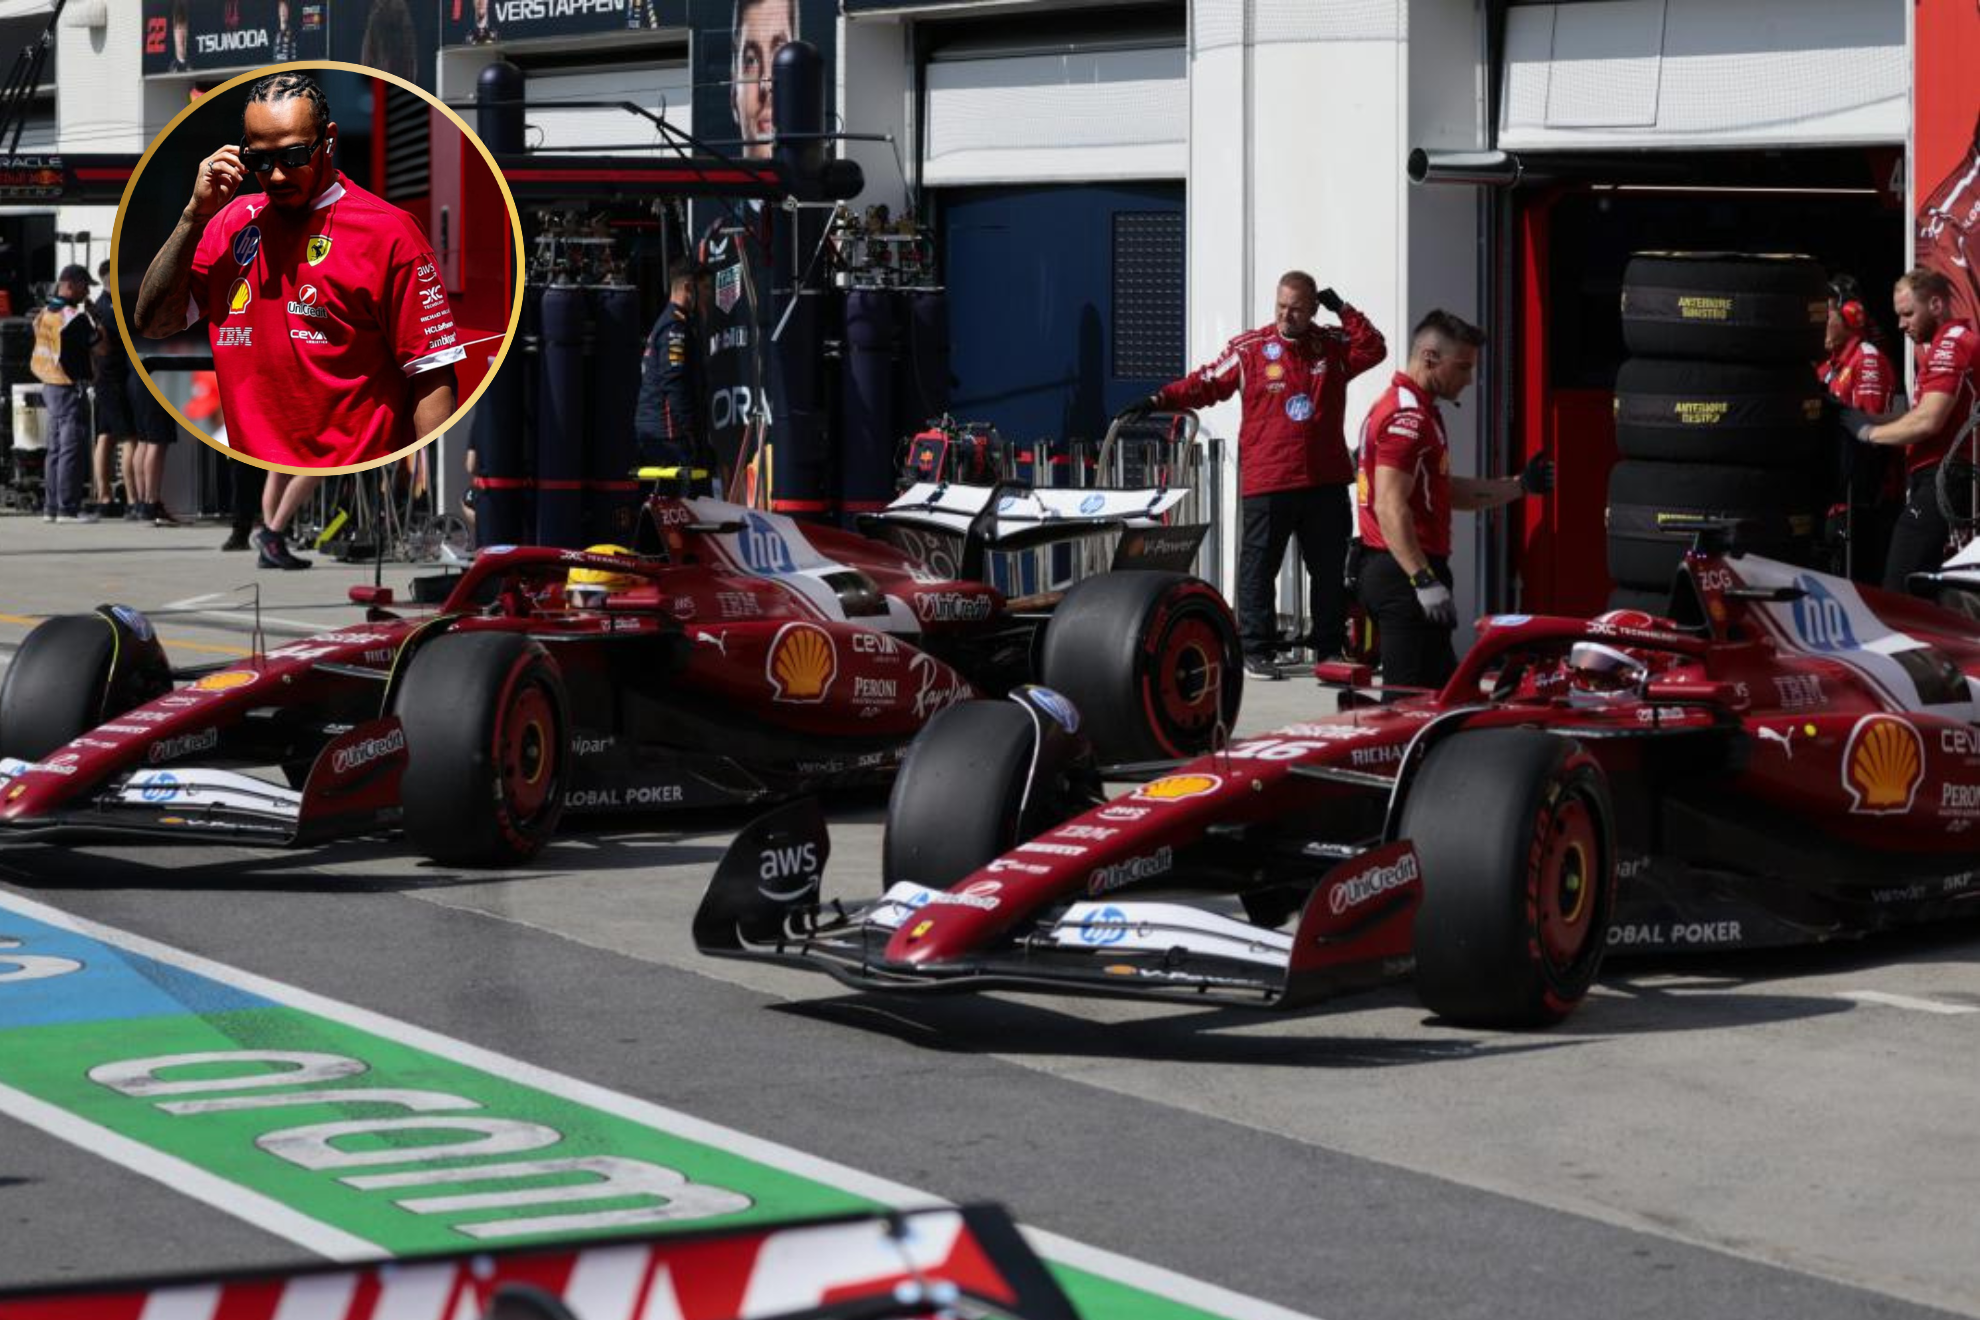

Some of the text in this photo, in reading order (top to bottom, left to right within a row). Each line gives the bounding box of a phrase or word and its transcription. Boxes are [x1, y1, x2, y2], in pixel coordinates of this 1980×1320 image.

[496, 0, 624, 23] VERSTAPPEN
[146, 17, 167, 54] 22
[196, 29, 269, 53] TSUNODA
[236, 226, 258, 266] hp
[417, 262, 436, 277] aws
[286, 301, 328, 318] UniCredit
[1678, 296, 1733, 309] ANTERIORE
[216, 326, 253, 346] IBM
[741, 512, 785, 575] hp
[1698, 569, 1732, 592] ZCG
[716, 591, 764, 618] IBM
[931, 592, 993, 621] UniCredit
[1796, 574, 1846, 652] hp
[854, 676, 896, 698] PERONI
[1773, 674, 1829, 708] IBM
[346, 729, 404, 767] UniCredit
[1215, 739, 1330, 761] 16
[625, 785, 684, 804] POKER
[760, 842, 817, 880] aws
[1346, 853, 1418, 906] UniCredit
[1082, 906, 1126, 944] hp
[1671, 920, 1742, 943] POKER
